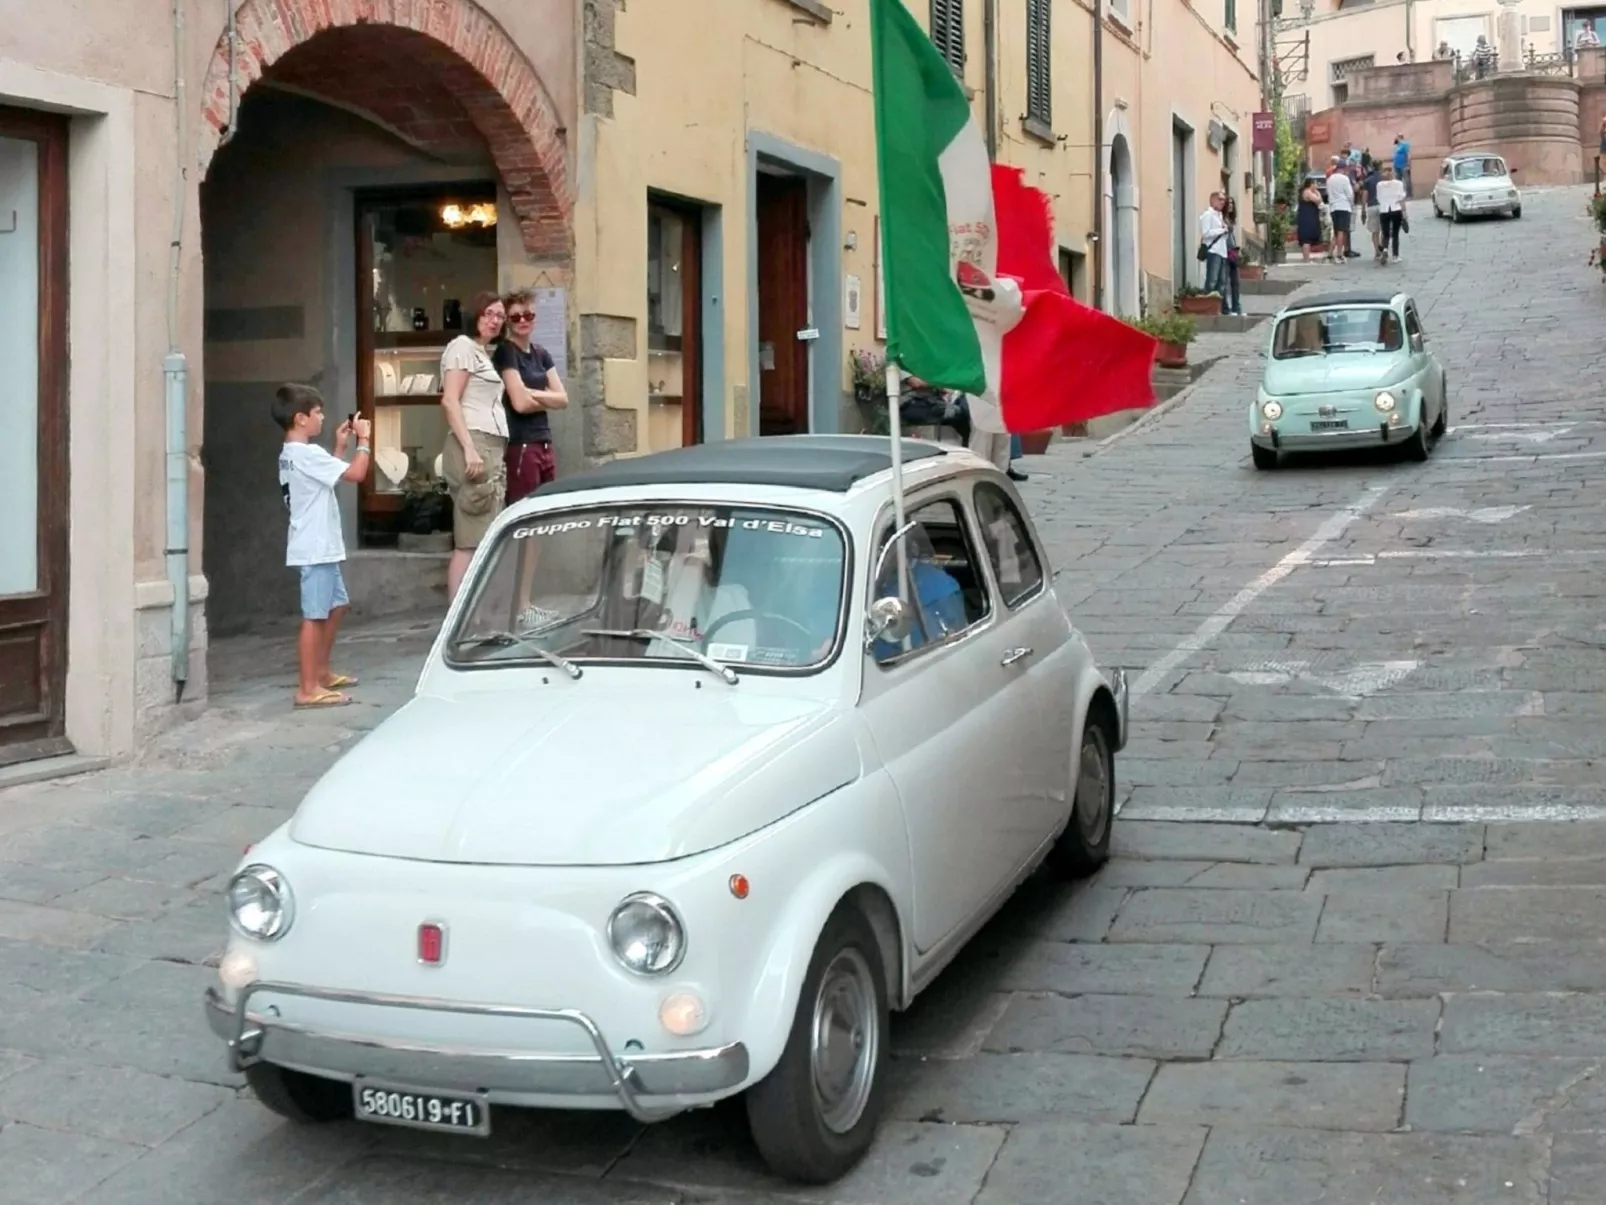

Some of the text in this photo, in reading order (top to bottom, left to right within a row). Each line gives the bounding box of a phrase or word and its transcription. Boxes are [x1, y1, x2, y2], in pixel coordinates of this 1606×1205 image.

[512, 515, 823, 539] Gruppo Fiat 500 Val d'Elsa
